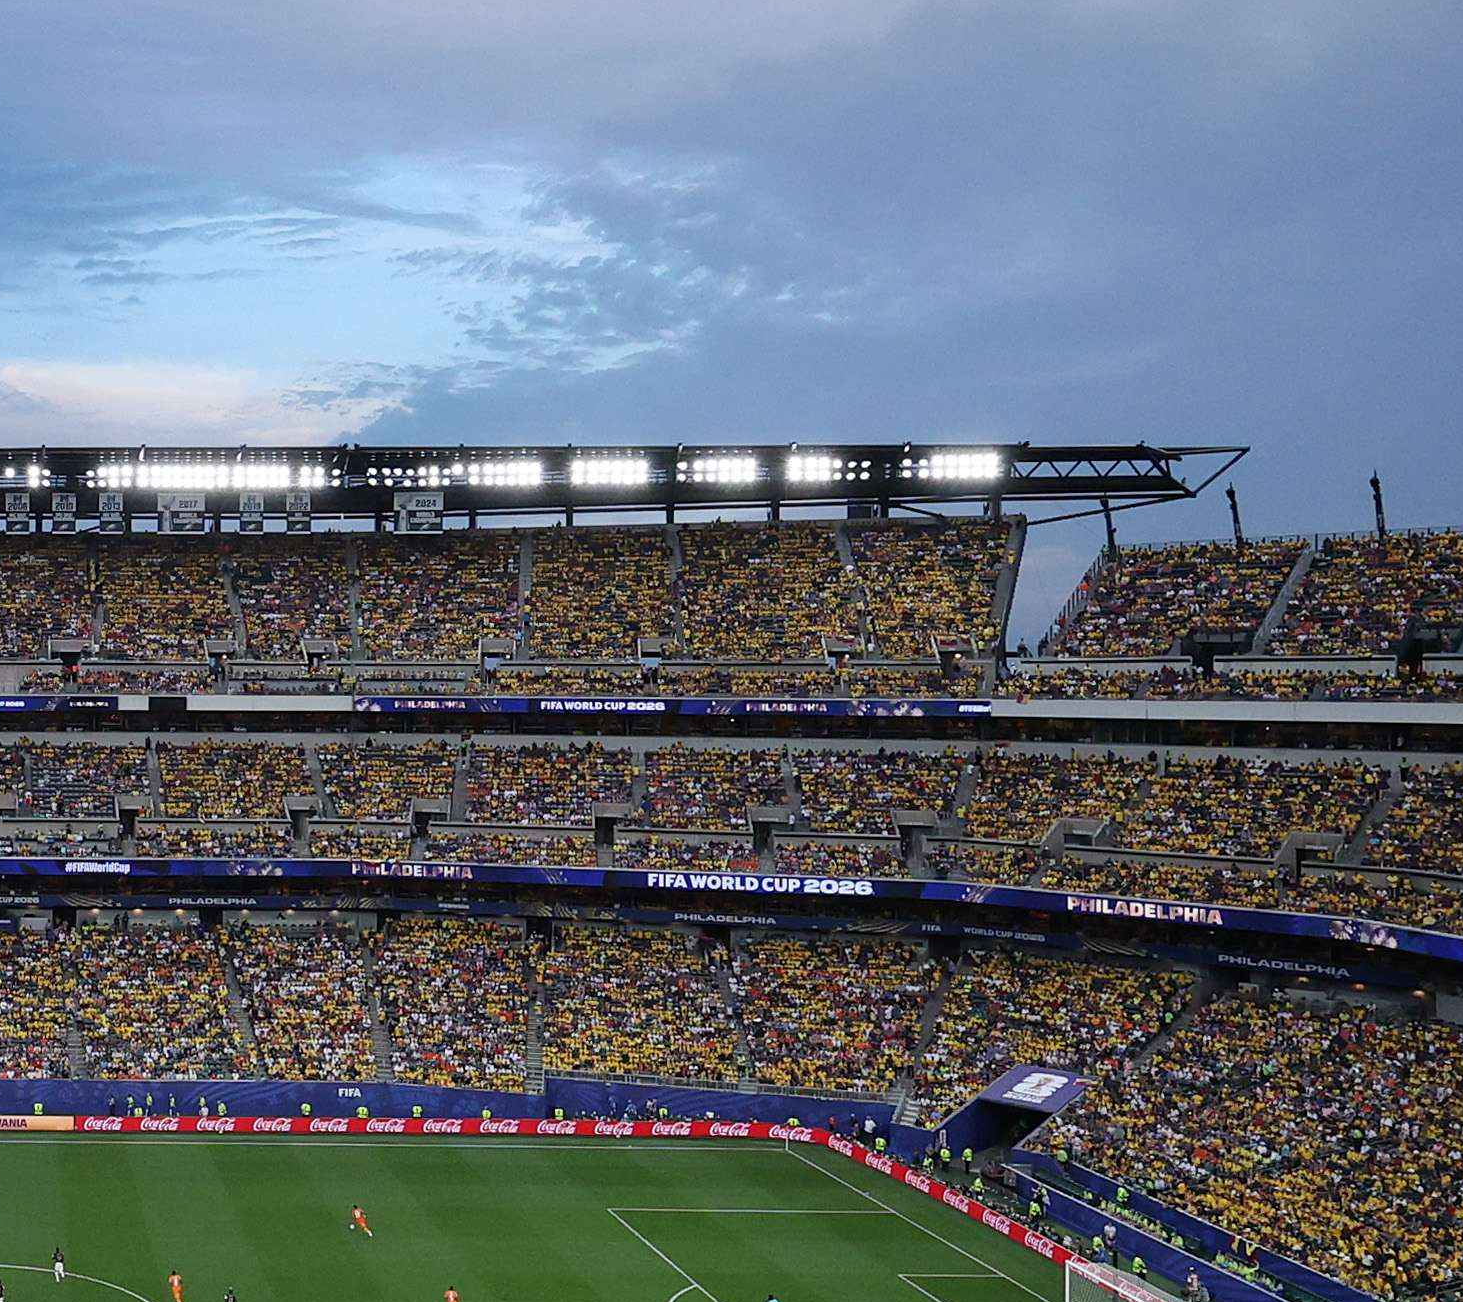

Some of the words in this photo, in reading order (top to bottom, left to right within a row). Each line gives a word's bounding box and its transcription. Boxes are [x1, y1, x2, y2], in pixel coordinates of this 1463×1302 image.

[540, 701, 563, 711] FIFA
[563, 701, 604, 711] WORLD
[604, 701, 626, 711] CUP
[627, 702, 665, 711] 2026
[647, 873, 688, 890] FIFA
[690, 874, 759, 892] WORLD
[762, 877, 801, 893] CUP
[803, 879, 874, 897] 2026
[168, 897, 257, 905] PHILADELPHIA
[1066, 898, 1223, 925] PHILADELPHIA
[674, 913, 777, 925] PHILADELPHIA
[921, 924, 942, 932] FIFA
[1217, 953, 1353, 978] PHILADELPHIA
[338, 1088, 362, 1097] FIFA
[866, 1152, 892, 1174] Coca-Cola
[905, 1170, 931, 1193] Coca-Cola
[943, 1188, 969, 1213] Coca-Cola
[982, 1210, 1011, 1235] Coca-Cola
[1024, 1231, 1053, 1258] Coca-Cola
